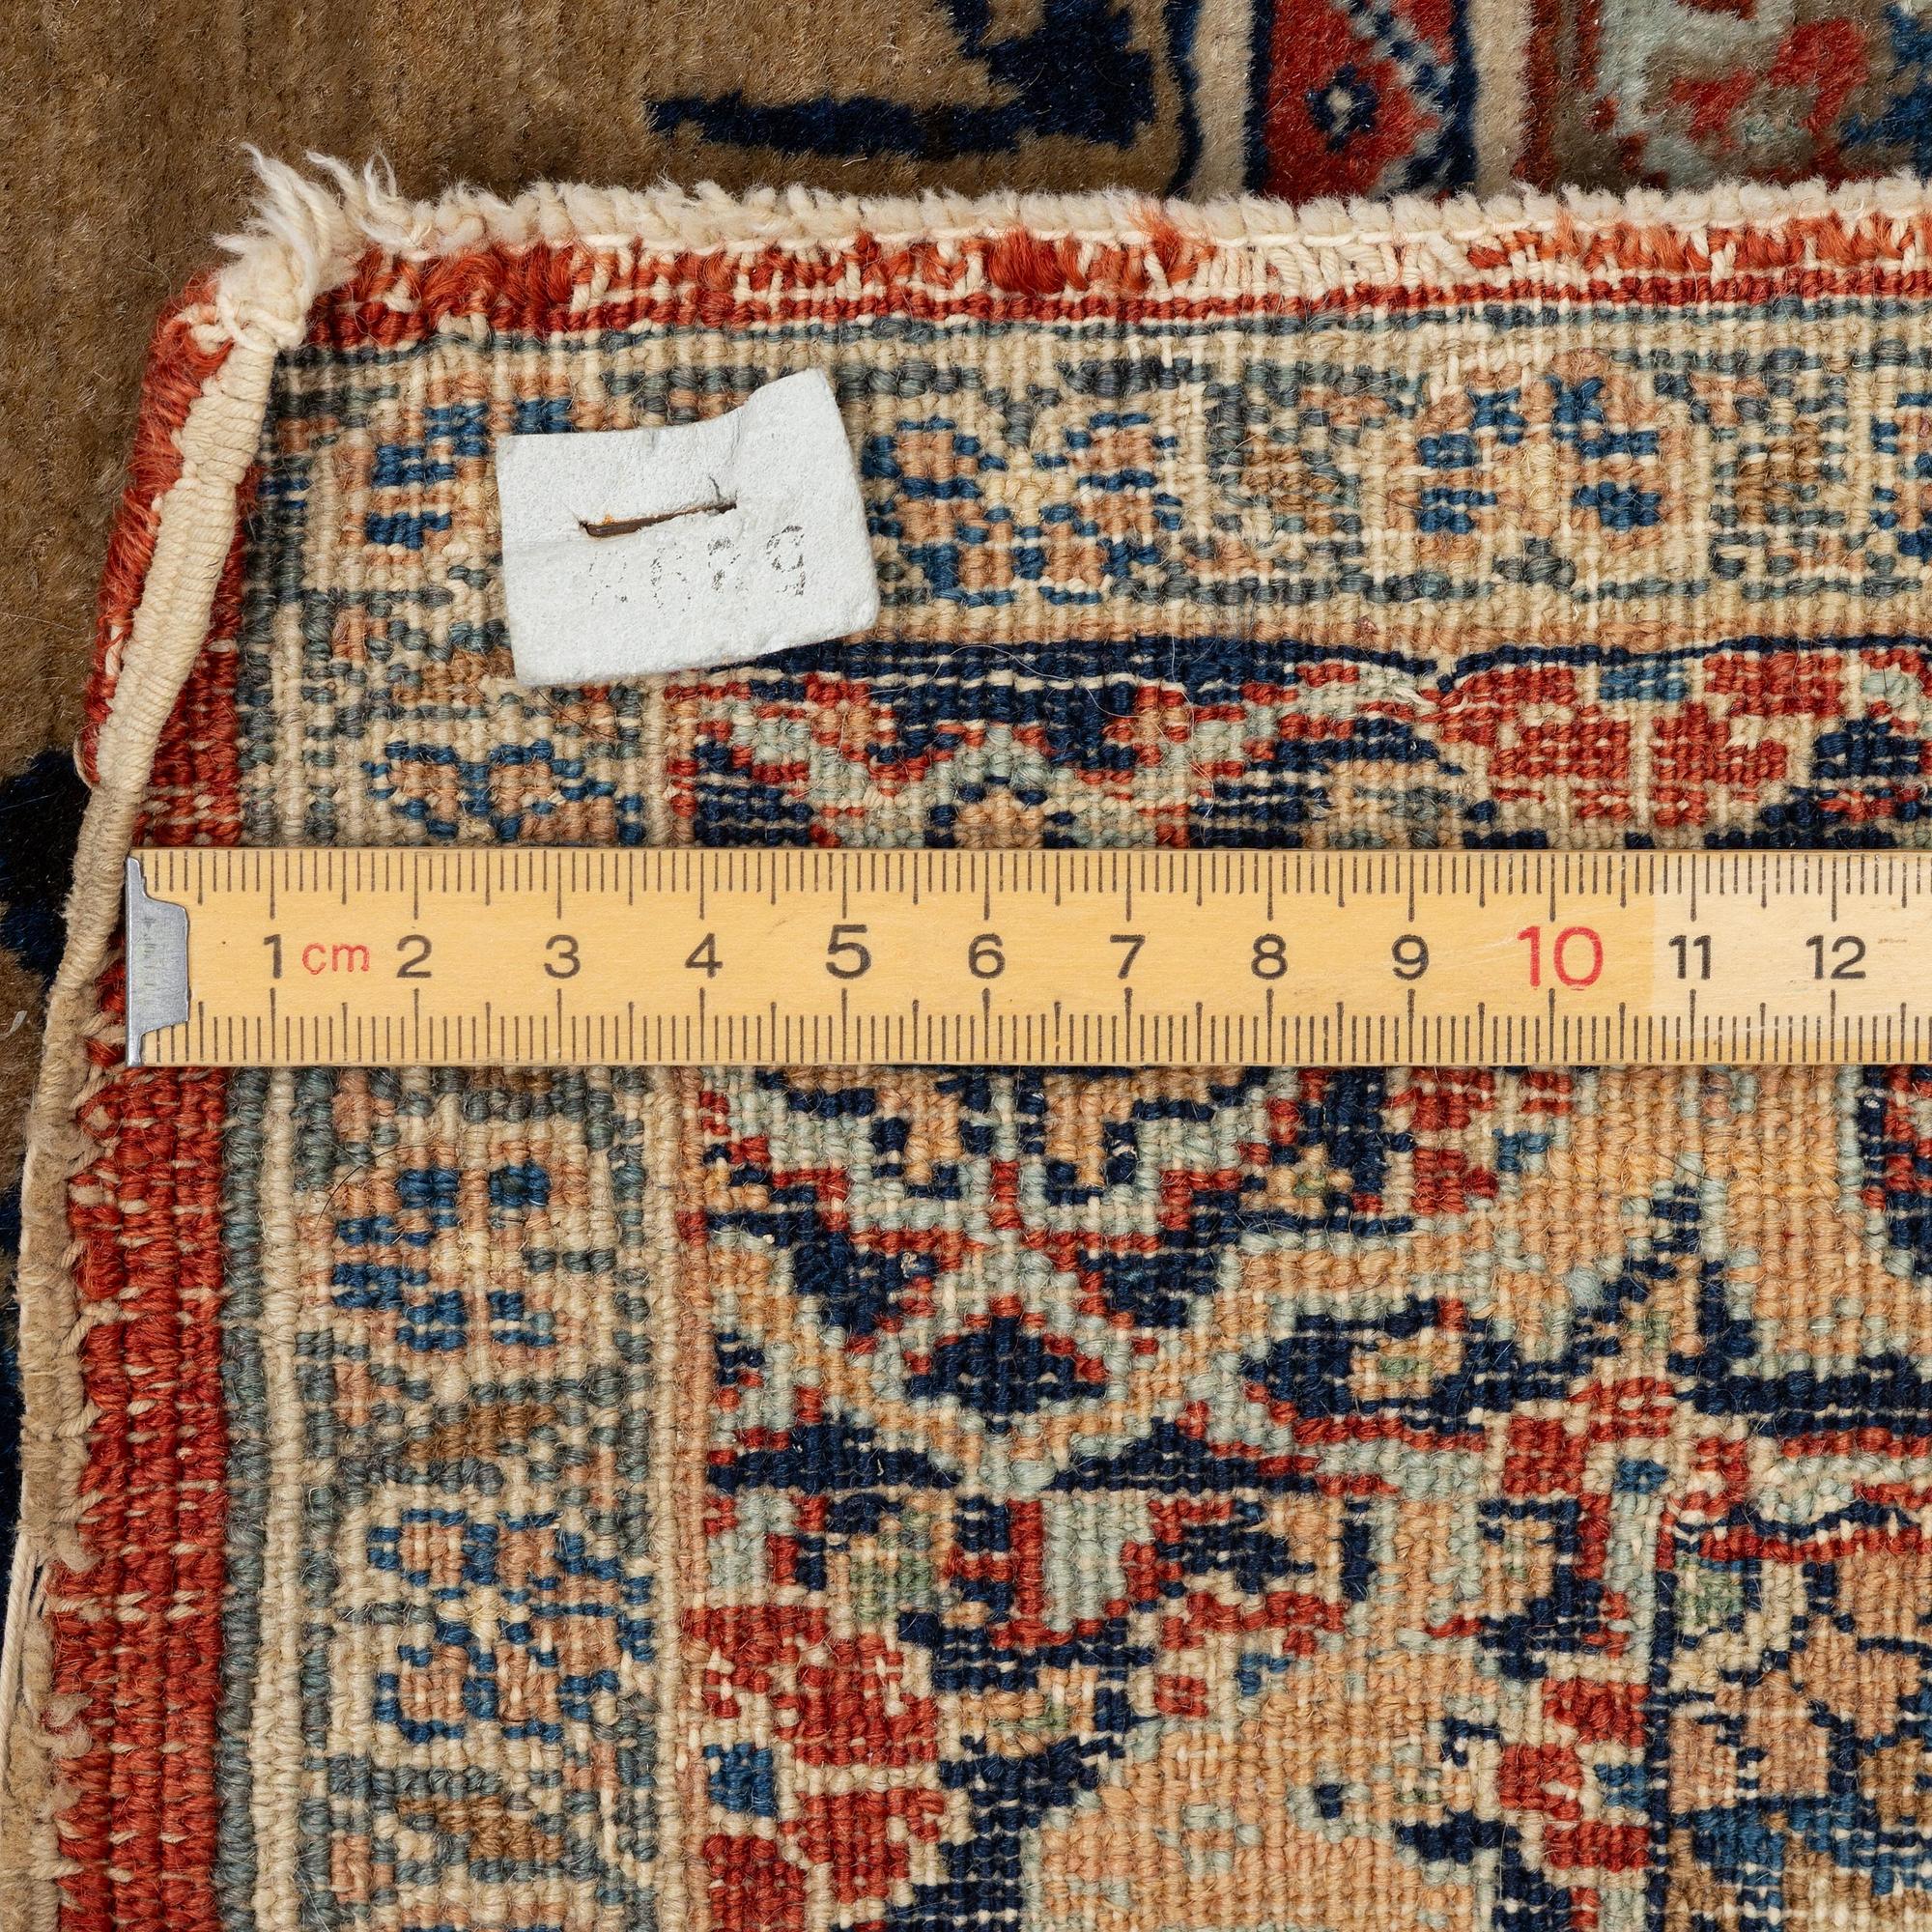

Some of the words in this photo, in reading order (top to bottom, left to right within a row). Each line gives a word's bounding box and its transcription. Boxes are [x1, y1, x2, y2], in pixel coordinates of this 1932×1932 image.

[264, 933, 282, 979] 1
[301, 943, 371, 974] cm
[396, 934, 432, 979] 2
[544, 934, 582, 979] 3
[685, 933, 724, 979] 4
[826, 923, 871, 980] 5
[968, 933, 1006, 980] 6
[1109, 934, 1146, 979] 7
[1251, 933, 1288, 980] 8
[1391, 934, 1430, 980] 9
[1517, 925, 1604, 987] 10
[1668, 934, 1712, 980] 11
[1805, 934, 1867, 980] 12
